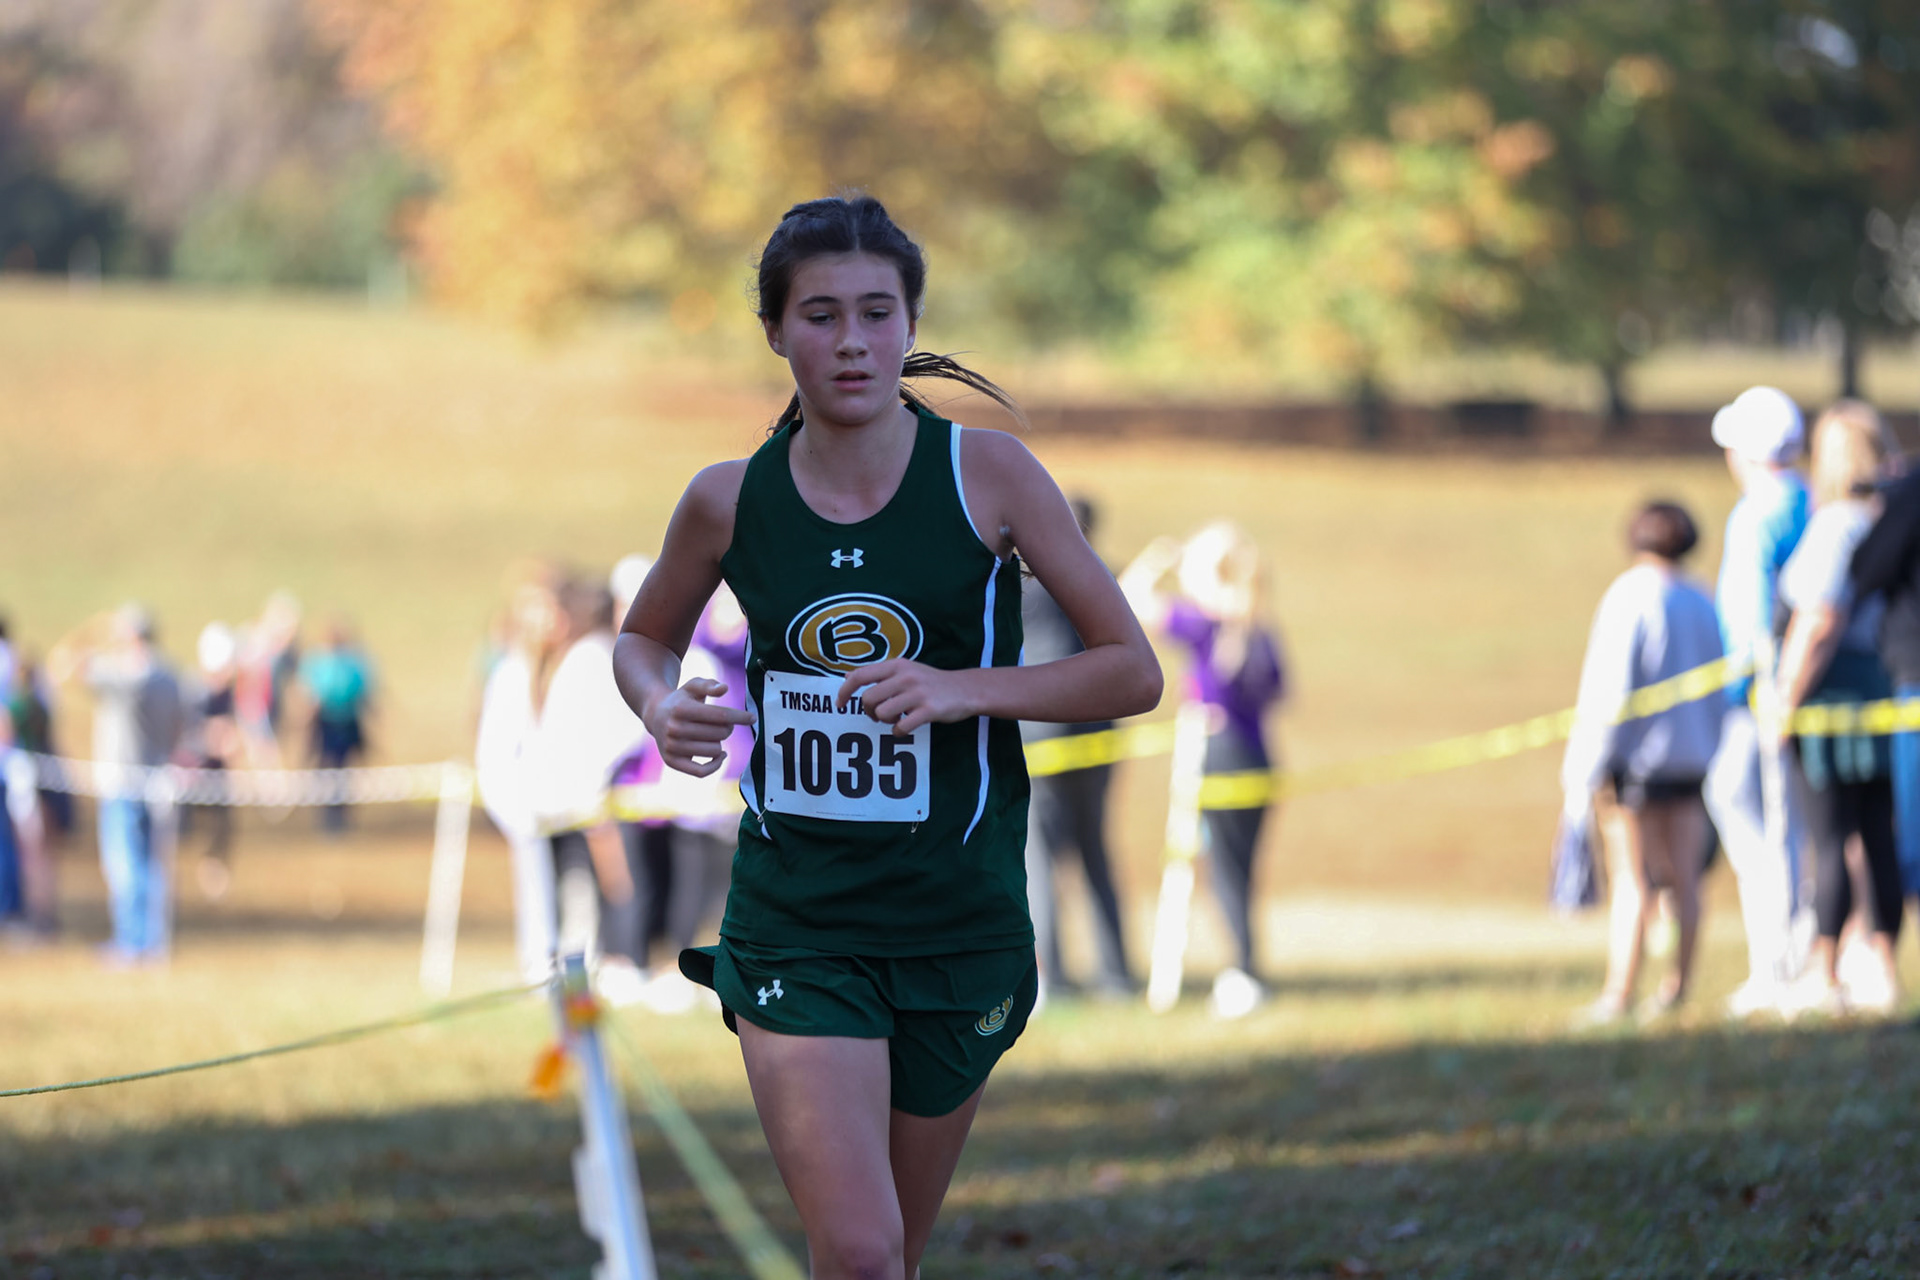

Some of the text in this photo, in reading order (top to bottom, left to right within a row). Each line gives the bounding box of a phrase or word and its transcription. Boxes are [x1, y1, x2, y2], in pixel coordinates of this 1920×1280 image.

[817, 612, 889, 665] B
[780, 690, 833, 714] TMSAA
[774, 727, 917, 799] 1035
